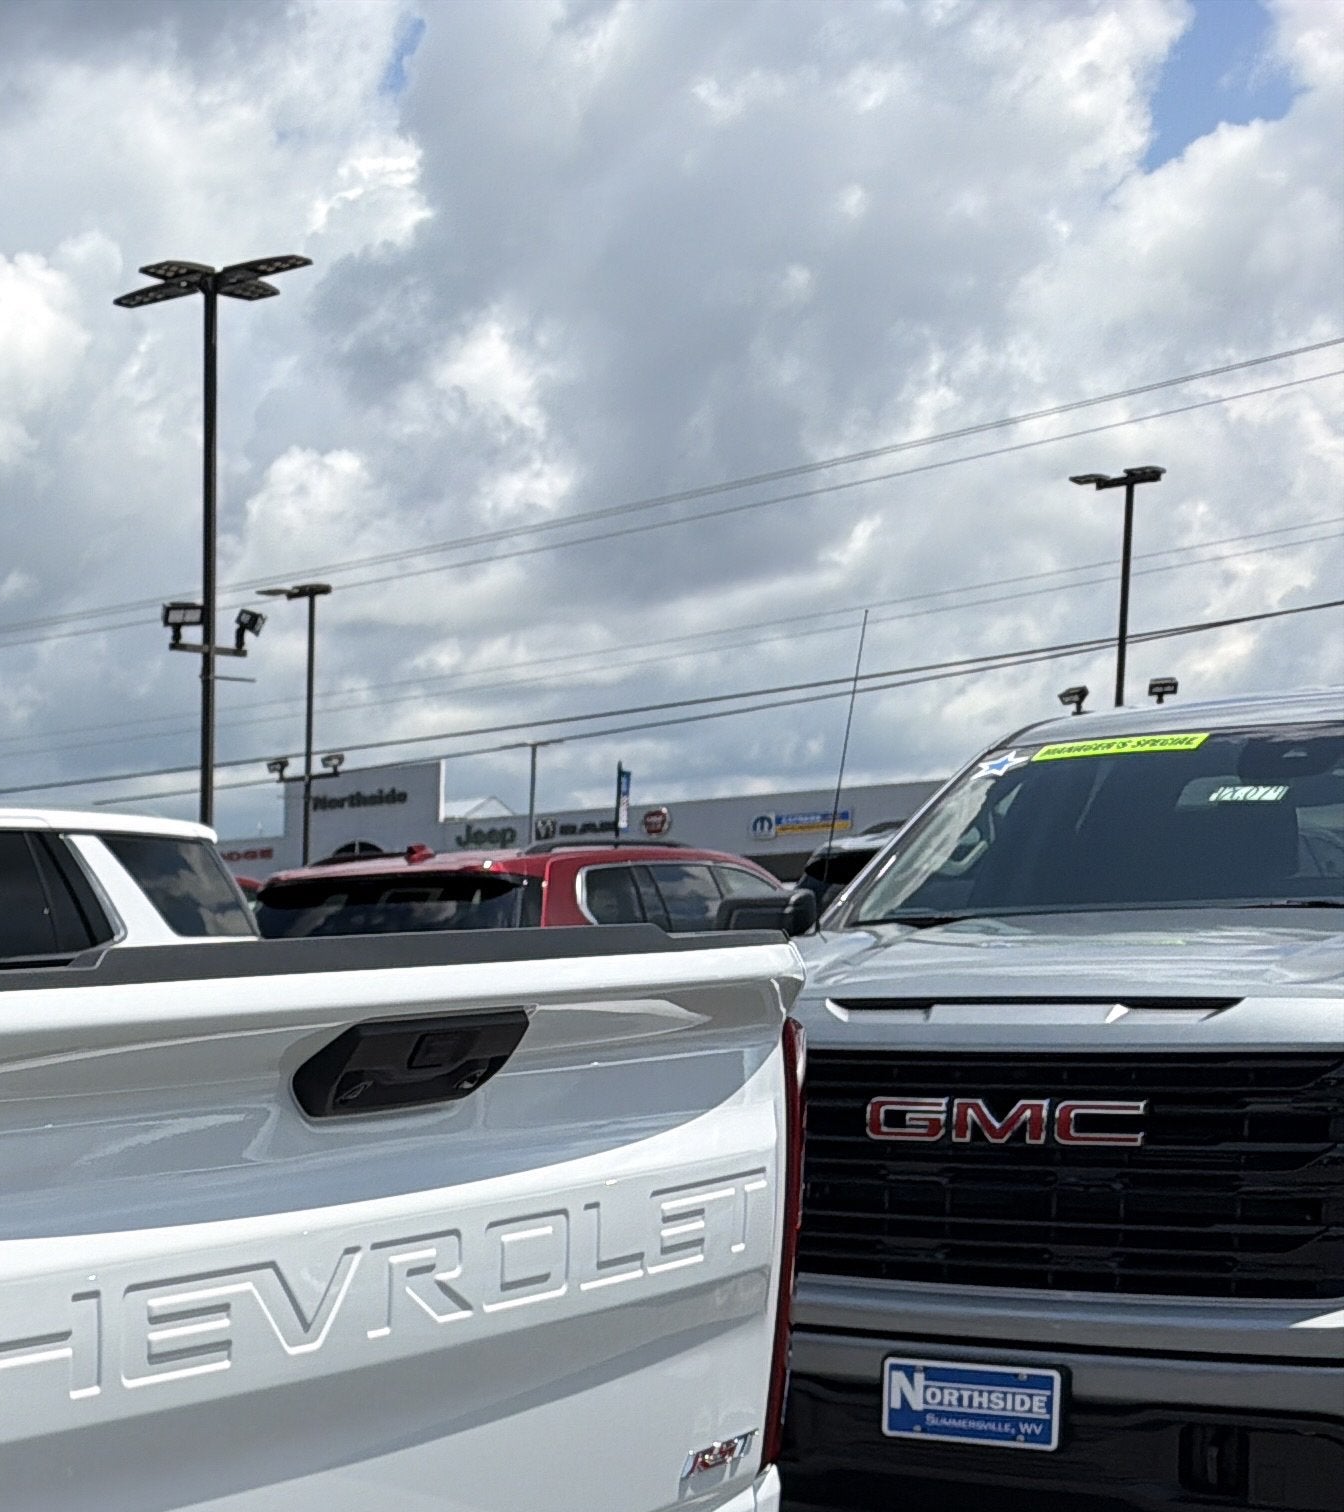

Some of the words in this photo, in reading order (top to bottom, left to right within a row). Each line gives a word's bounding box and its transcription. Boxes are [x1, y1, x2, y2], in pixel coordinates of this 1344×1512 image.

[1131, 736, 1199, 749] SPECIAL
[312, 787, 407, 812] Northside
[455, 824, 517, 848] Jeep
[866, 1096, 1148, 1146] GMC
[890, 1370, 1048, 1414] NORTHSIDE
[1018, 1422, 1044, 1436] WV
[680, 1428, 759, 1480] RST
